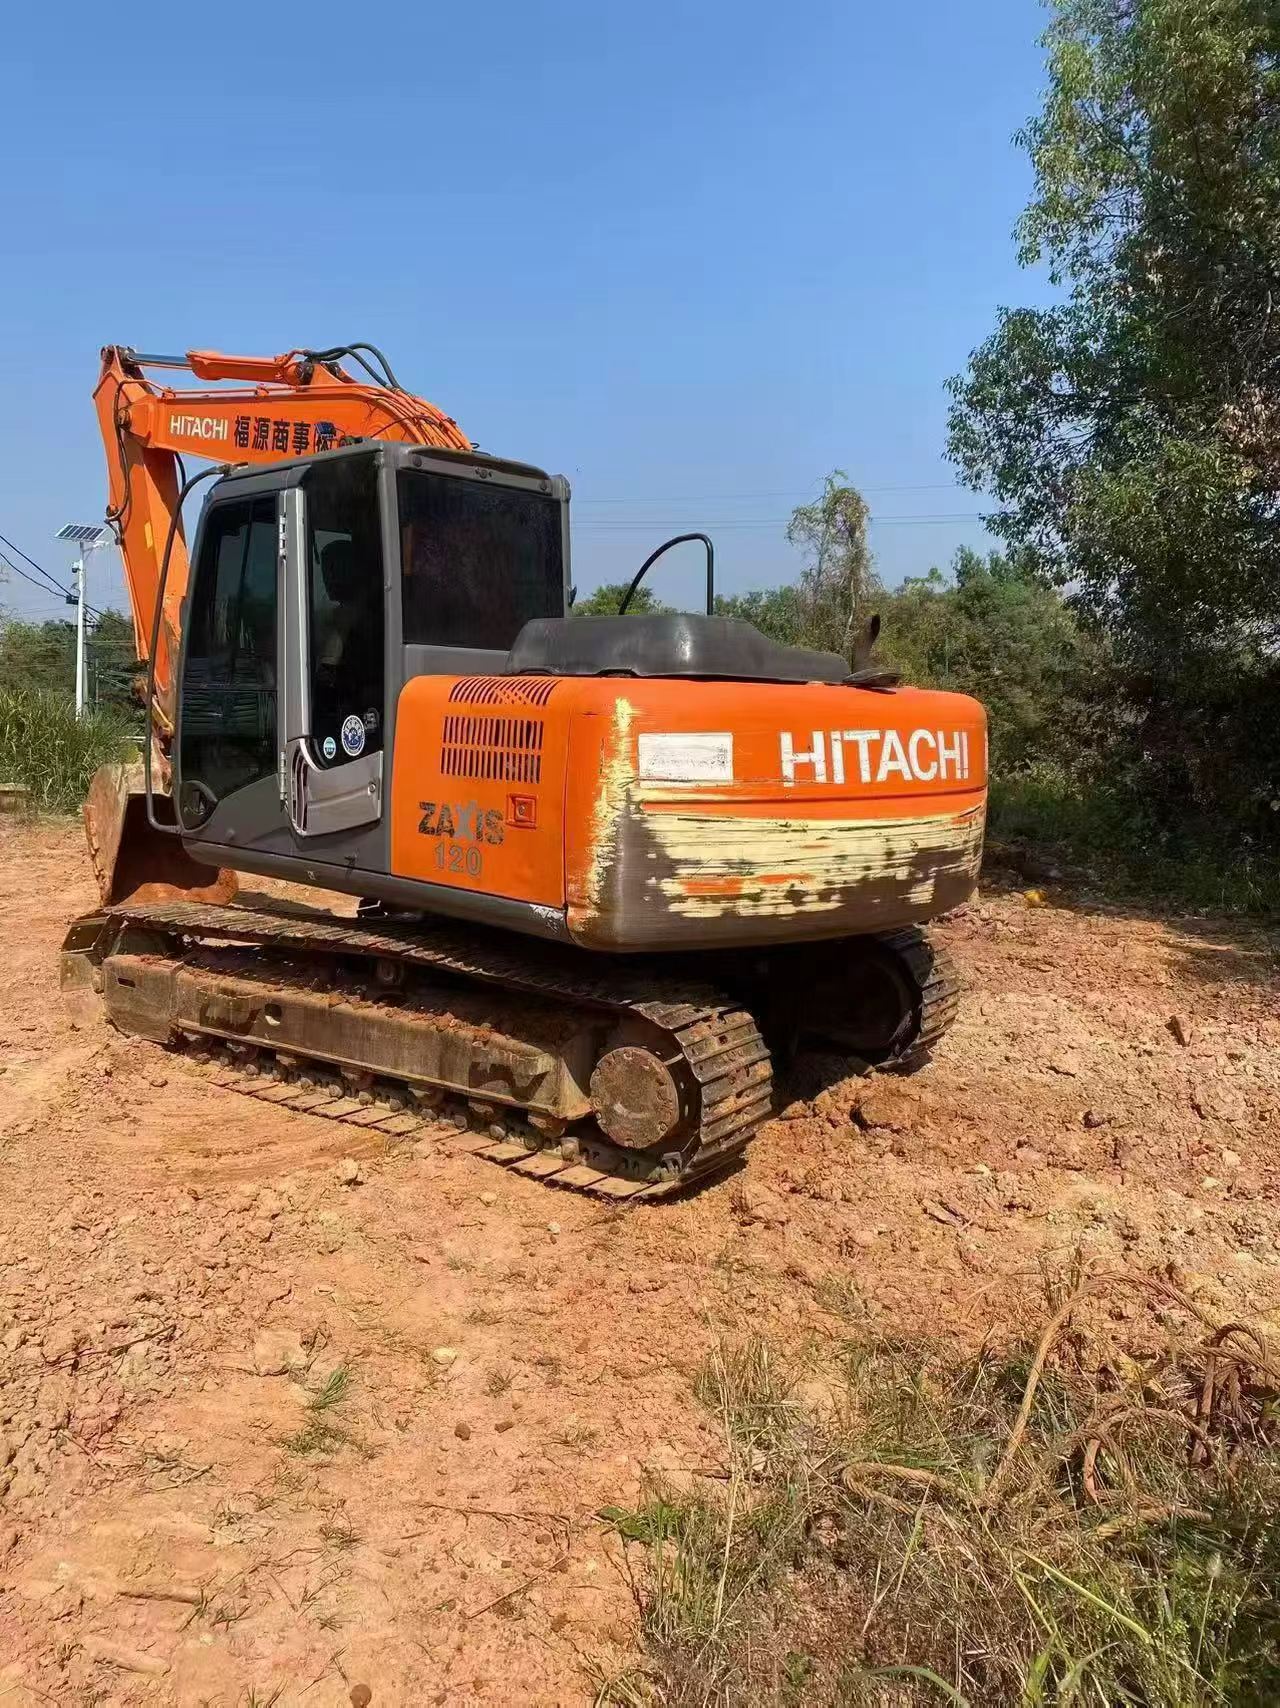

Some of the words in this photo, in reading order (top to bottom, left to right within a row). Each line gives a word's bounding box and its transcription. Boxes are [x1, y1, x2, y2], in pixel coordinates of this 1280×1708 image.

[170, 415, 228, 440] HITACHI
[780, 729, 969, 787] HITACHI
[418, 799, 504, 846] ZAXIS
[434, 841, 482, 877] 120
